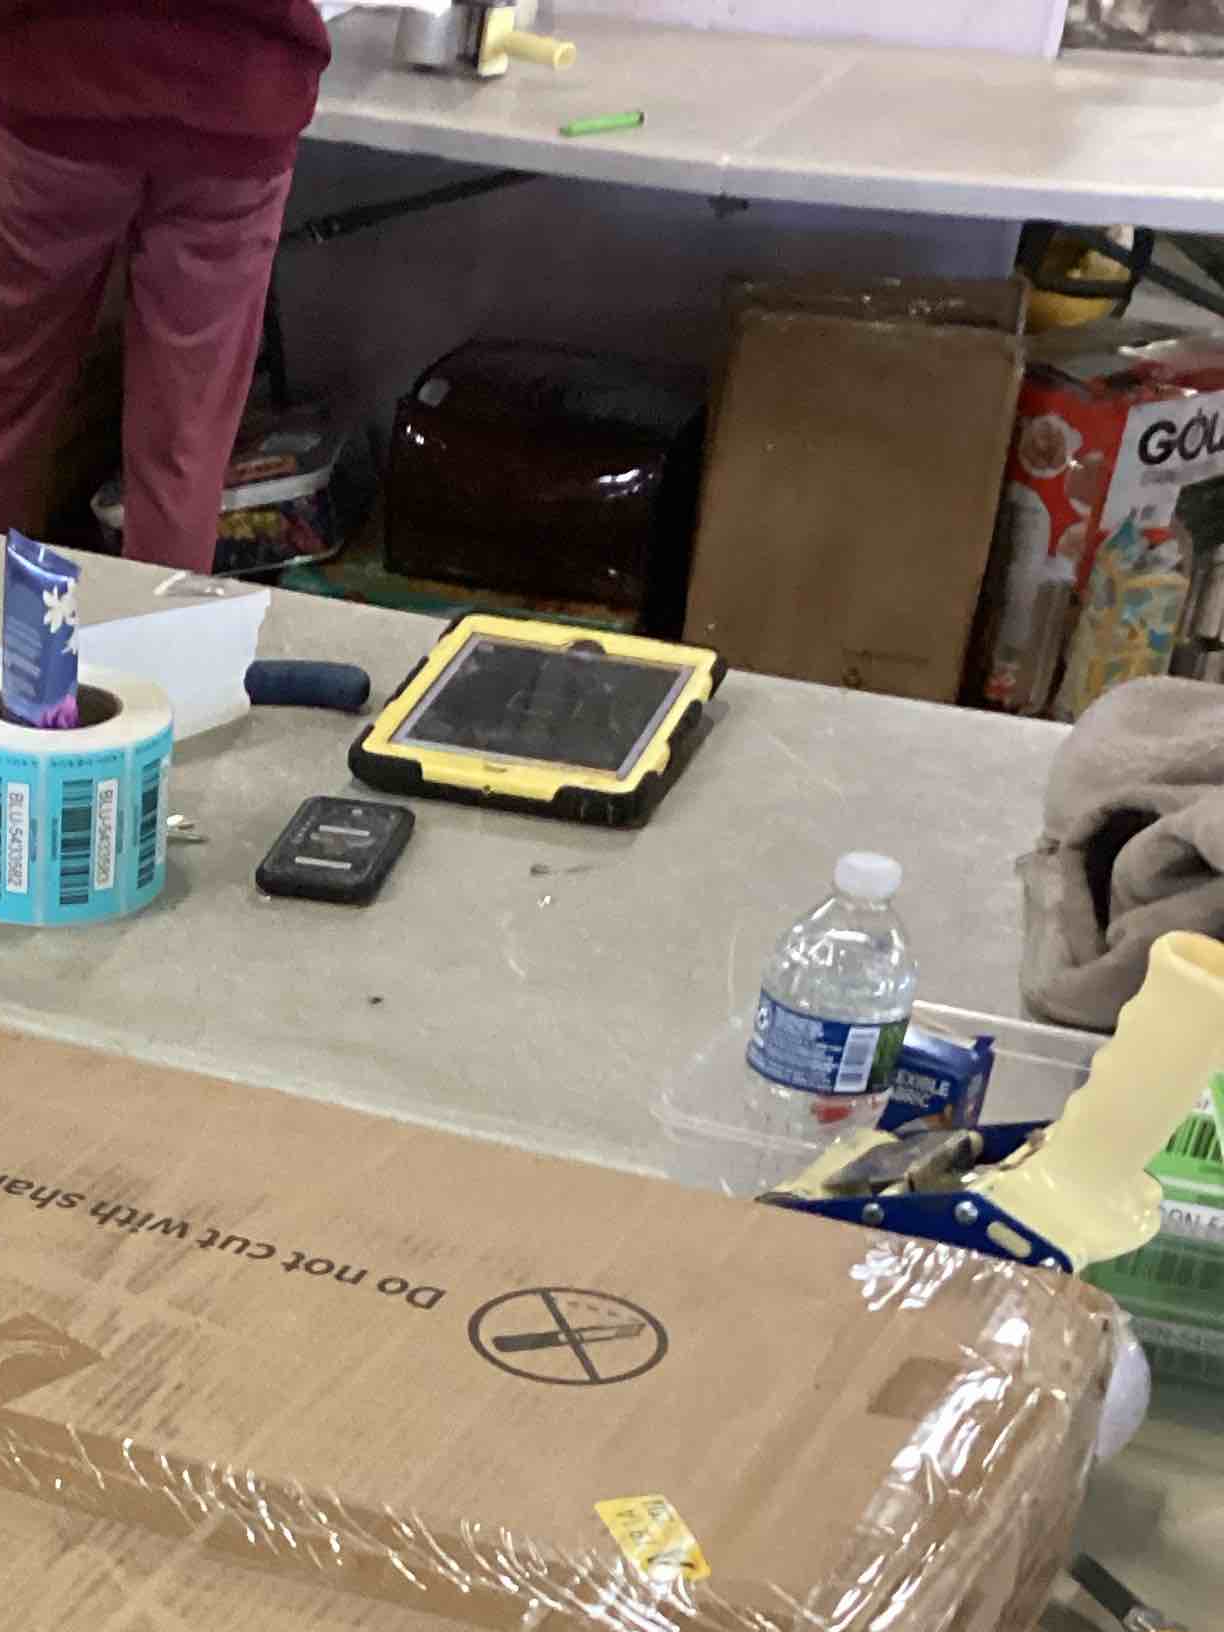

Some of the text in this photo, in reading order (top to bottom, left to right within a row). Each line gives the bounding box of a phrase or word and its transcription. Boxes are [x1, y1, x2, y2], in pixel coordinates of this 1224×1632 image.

[89, 1196, 190, 1239] with
[198, 1225, 276, 1262] cut
[282, 1248, 368, 1287] not
[376, 1272, 446, 1311] Do
